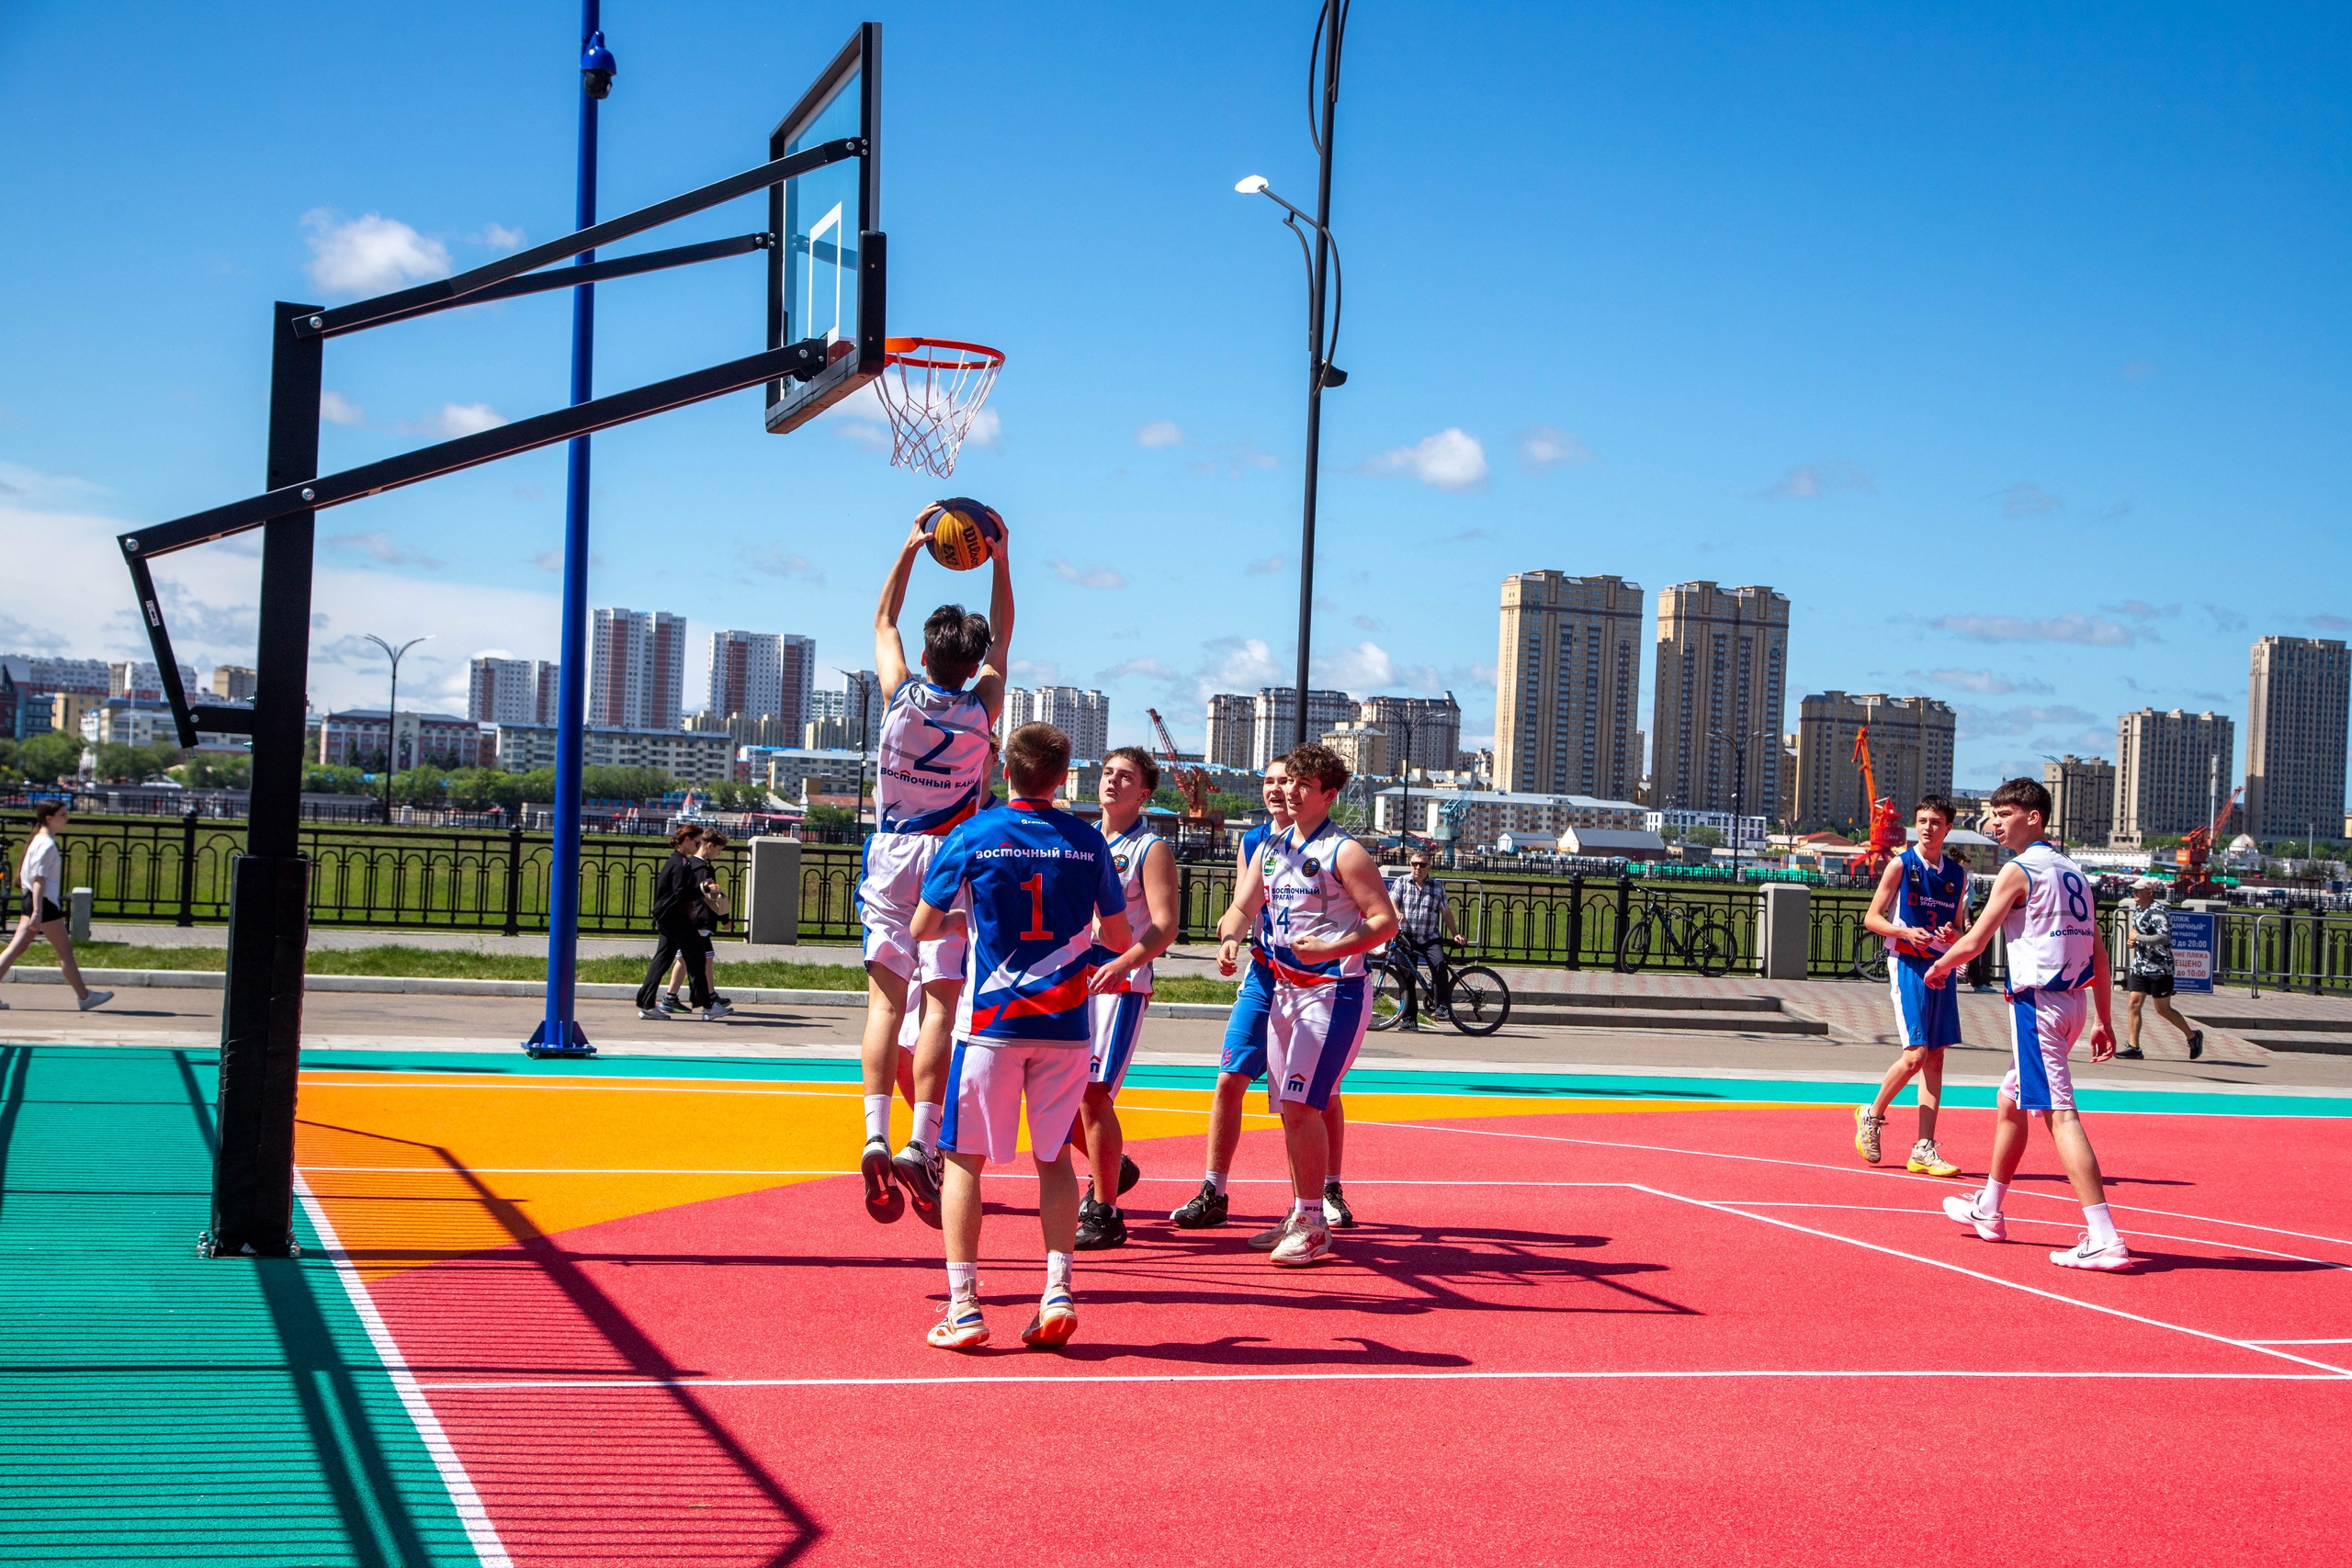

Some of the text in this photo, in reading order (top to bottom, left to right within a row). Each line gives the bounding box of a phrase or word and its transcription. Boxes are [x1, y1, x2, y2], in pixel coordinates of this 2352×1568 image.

[913, 719, 955, 775] 2
[880, 767, 951, 789] ВОСТОЧНЫЙ
[976, 846, 1094, 862] ВОСТОЧНЫЙ БАНК
[1272, 886, 1320, 895] ВОСТОЧНЫЙ
[2063, 872, 2087, 922] 8
[1020, 874, 1054, 940] 1
[1276, 906, 1291, 934] 4
[1926, 910, 1938, 931] 3
[2188, 940, 2207, 948] 20:00
[2175, 959, 2202, 968] ЕЩЕНО
[2188, 969, 2207, 977] 10:00
